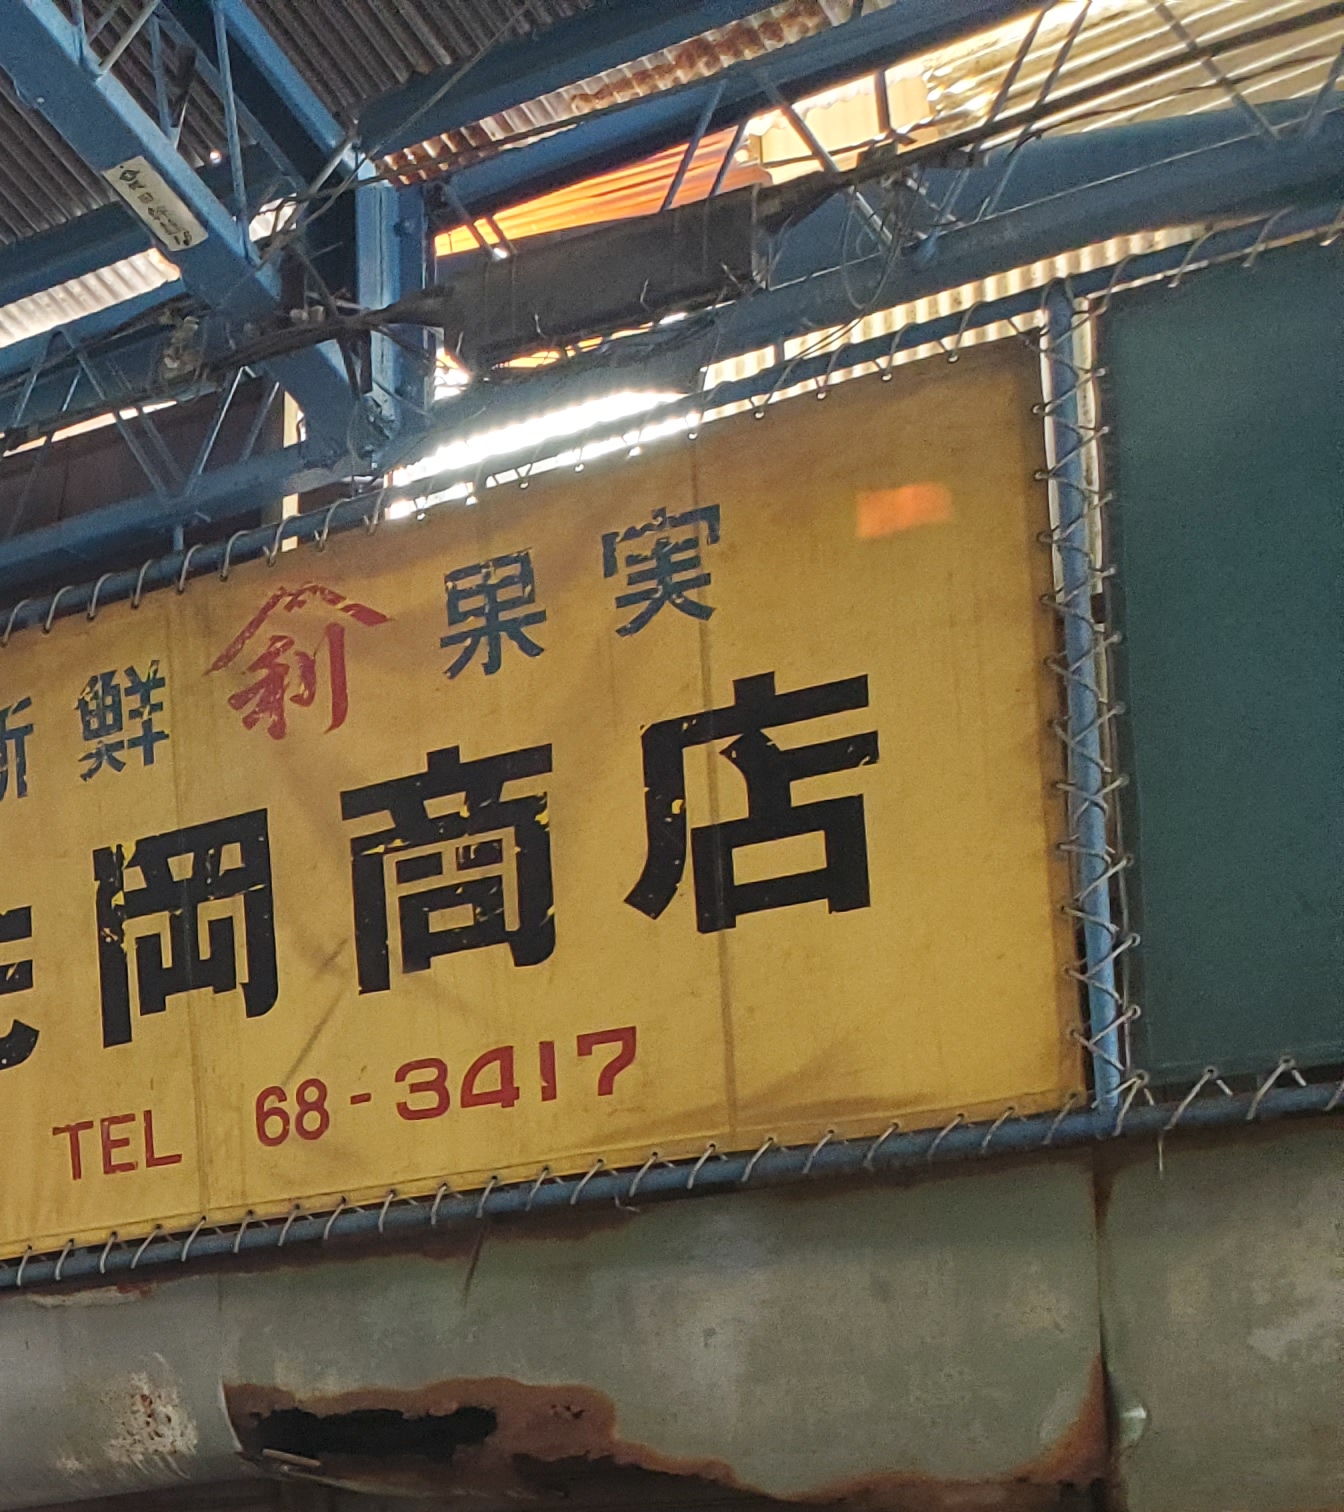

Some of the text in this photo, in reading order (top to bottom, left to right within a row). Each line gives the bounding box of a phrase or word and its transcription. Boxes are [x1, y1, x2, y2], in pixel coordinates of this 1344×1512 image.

[438, 503, 723, 681] 果実
[52, 1026, 639, 1181] TEL 68-3417
